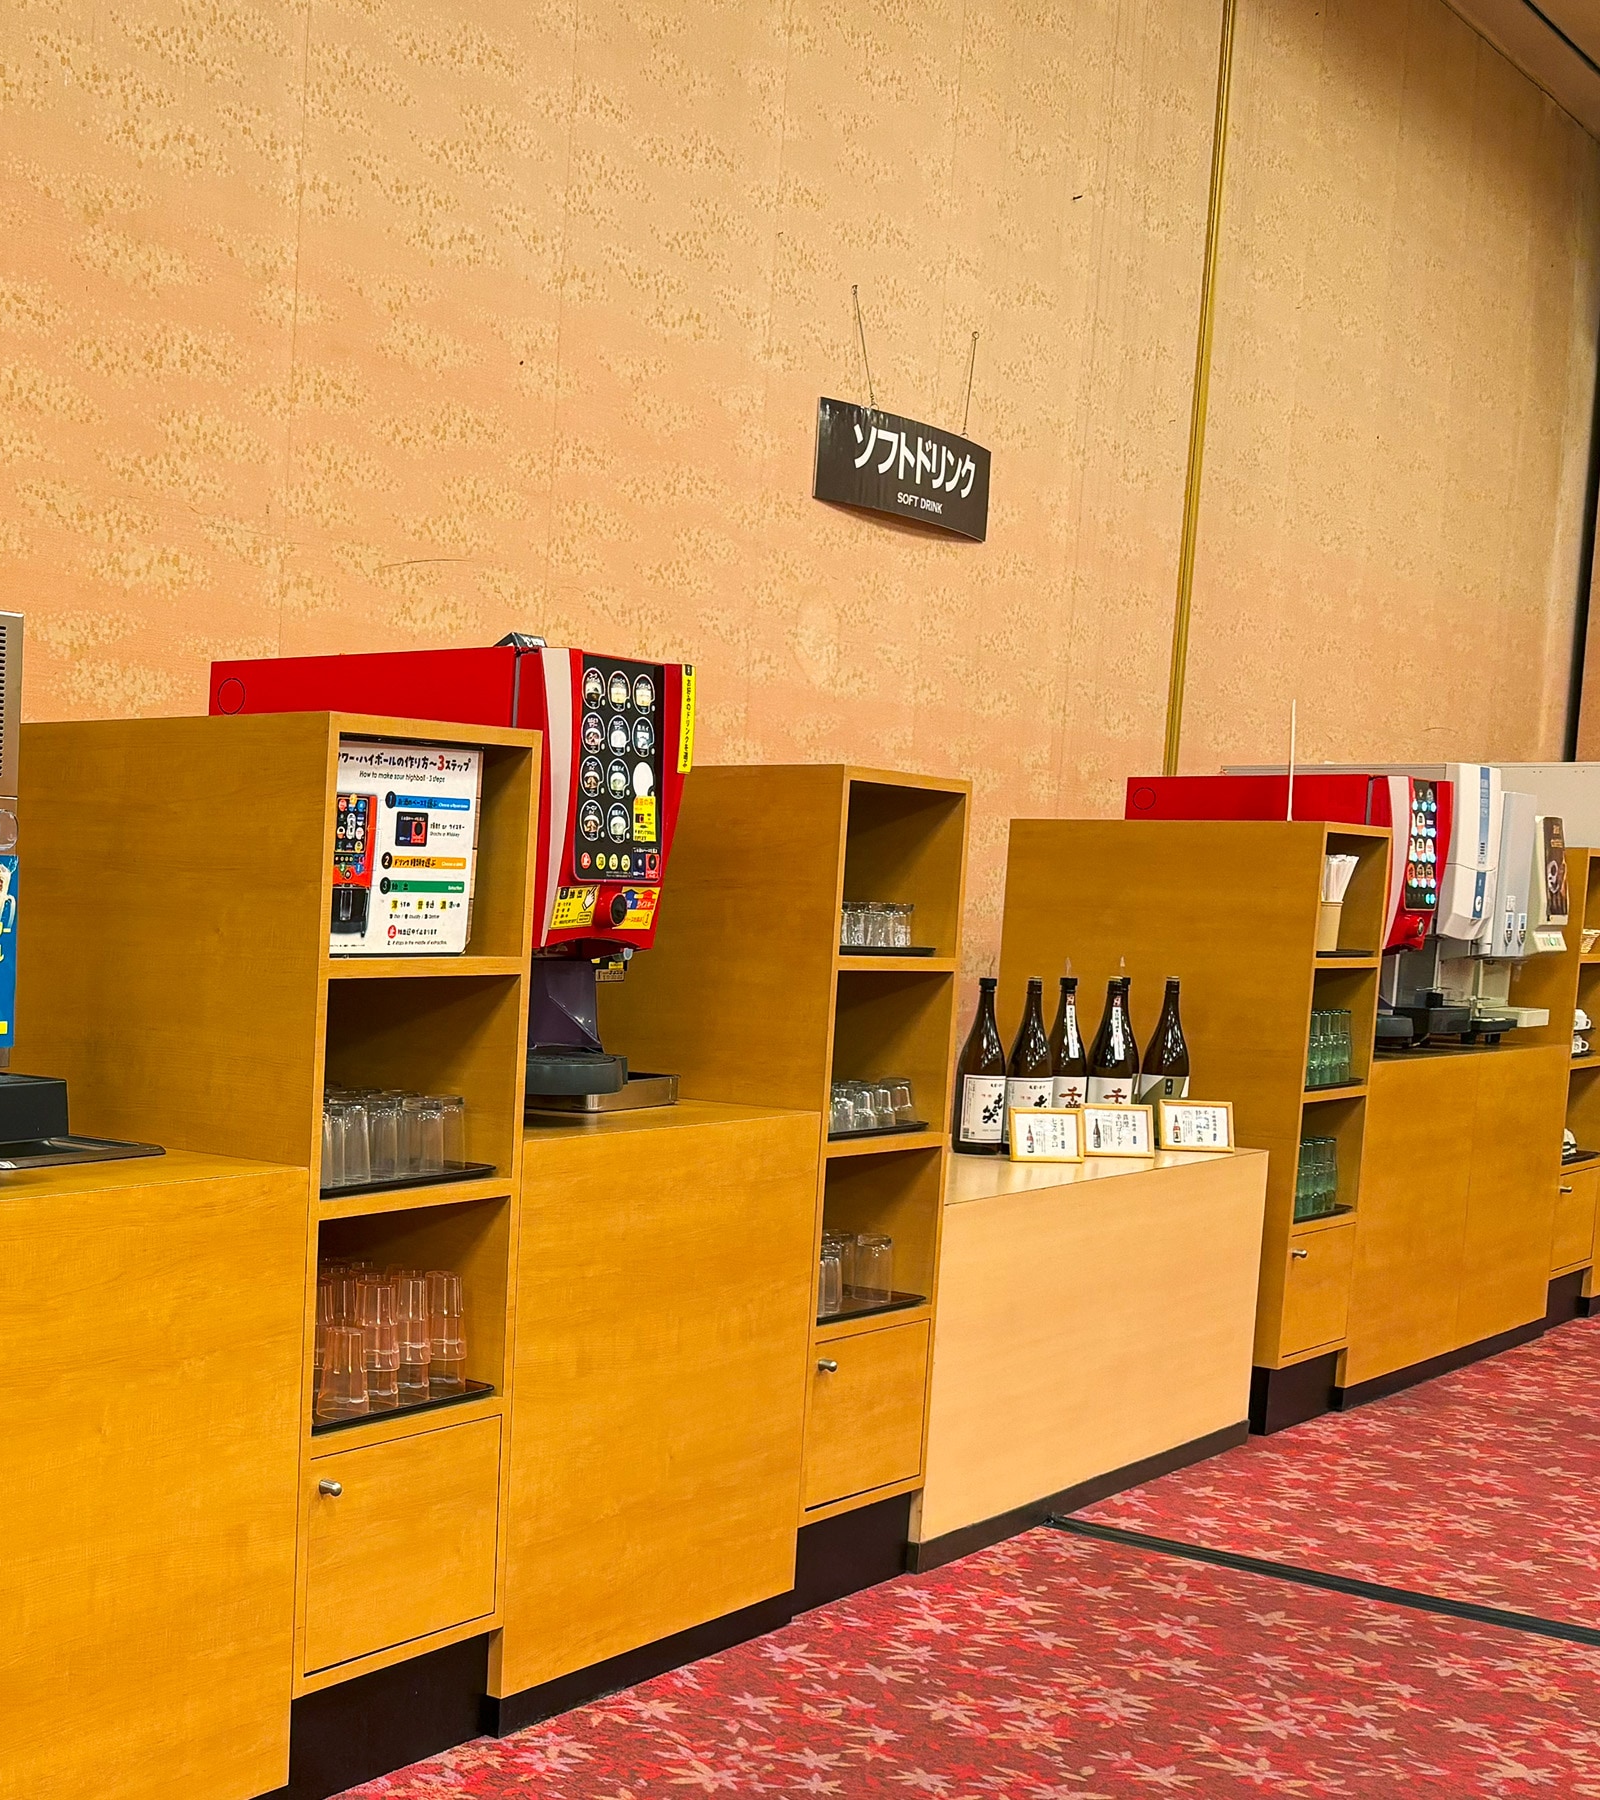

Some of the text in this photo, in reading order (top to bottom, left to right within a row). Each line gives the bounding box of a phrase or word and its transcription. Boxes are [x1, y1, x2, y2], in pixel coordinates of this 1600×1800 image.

[853, 423, 976, 499] ソフトドリンク
[896, 491, 943, 515] SOFT DRINK
[359, 770, 371, 778] How
[378, 772, 393, 780] make
[405, 774, 426, 782] highball
